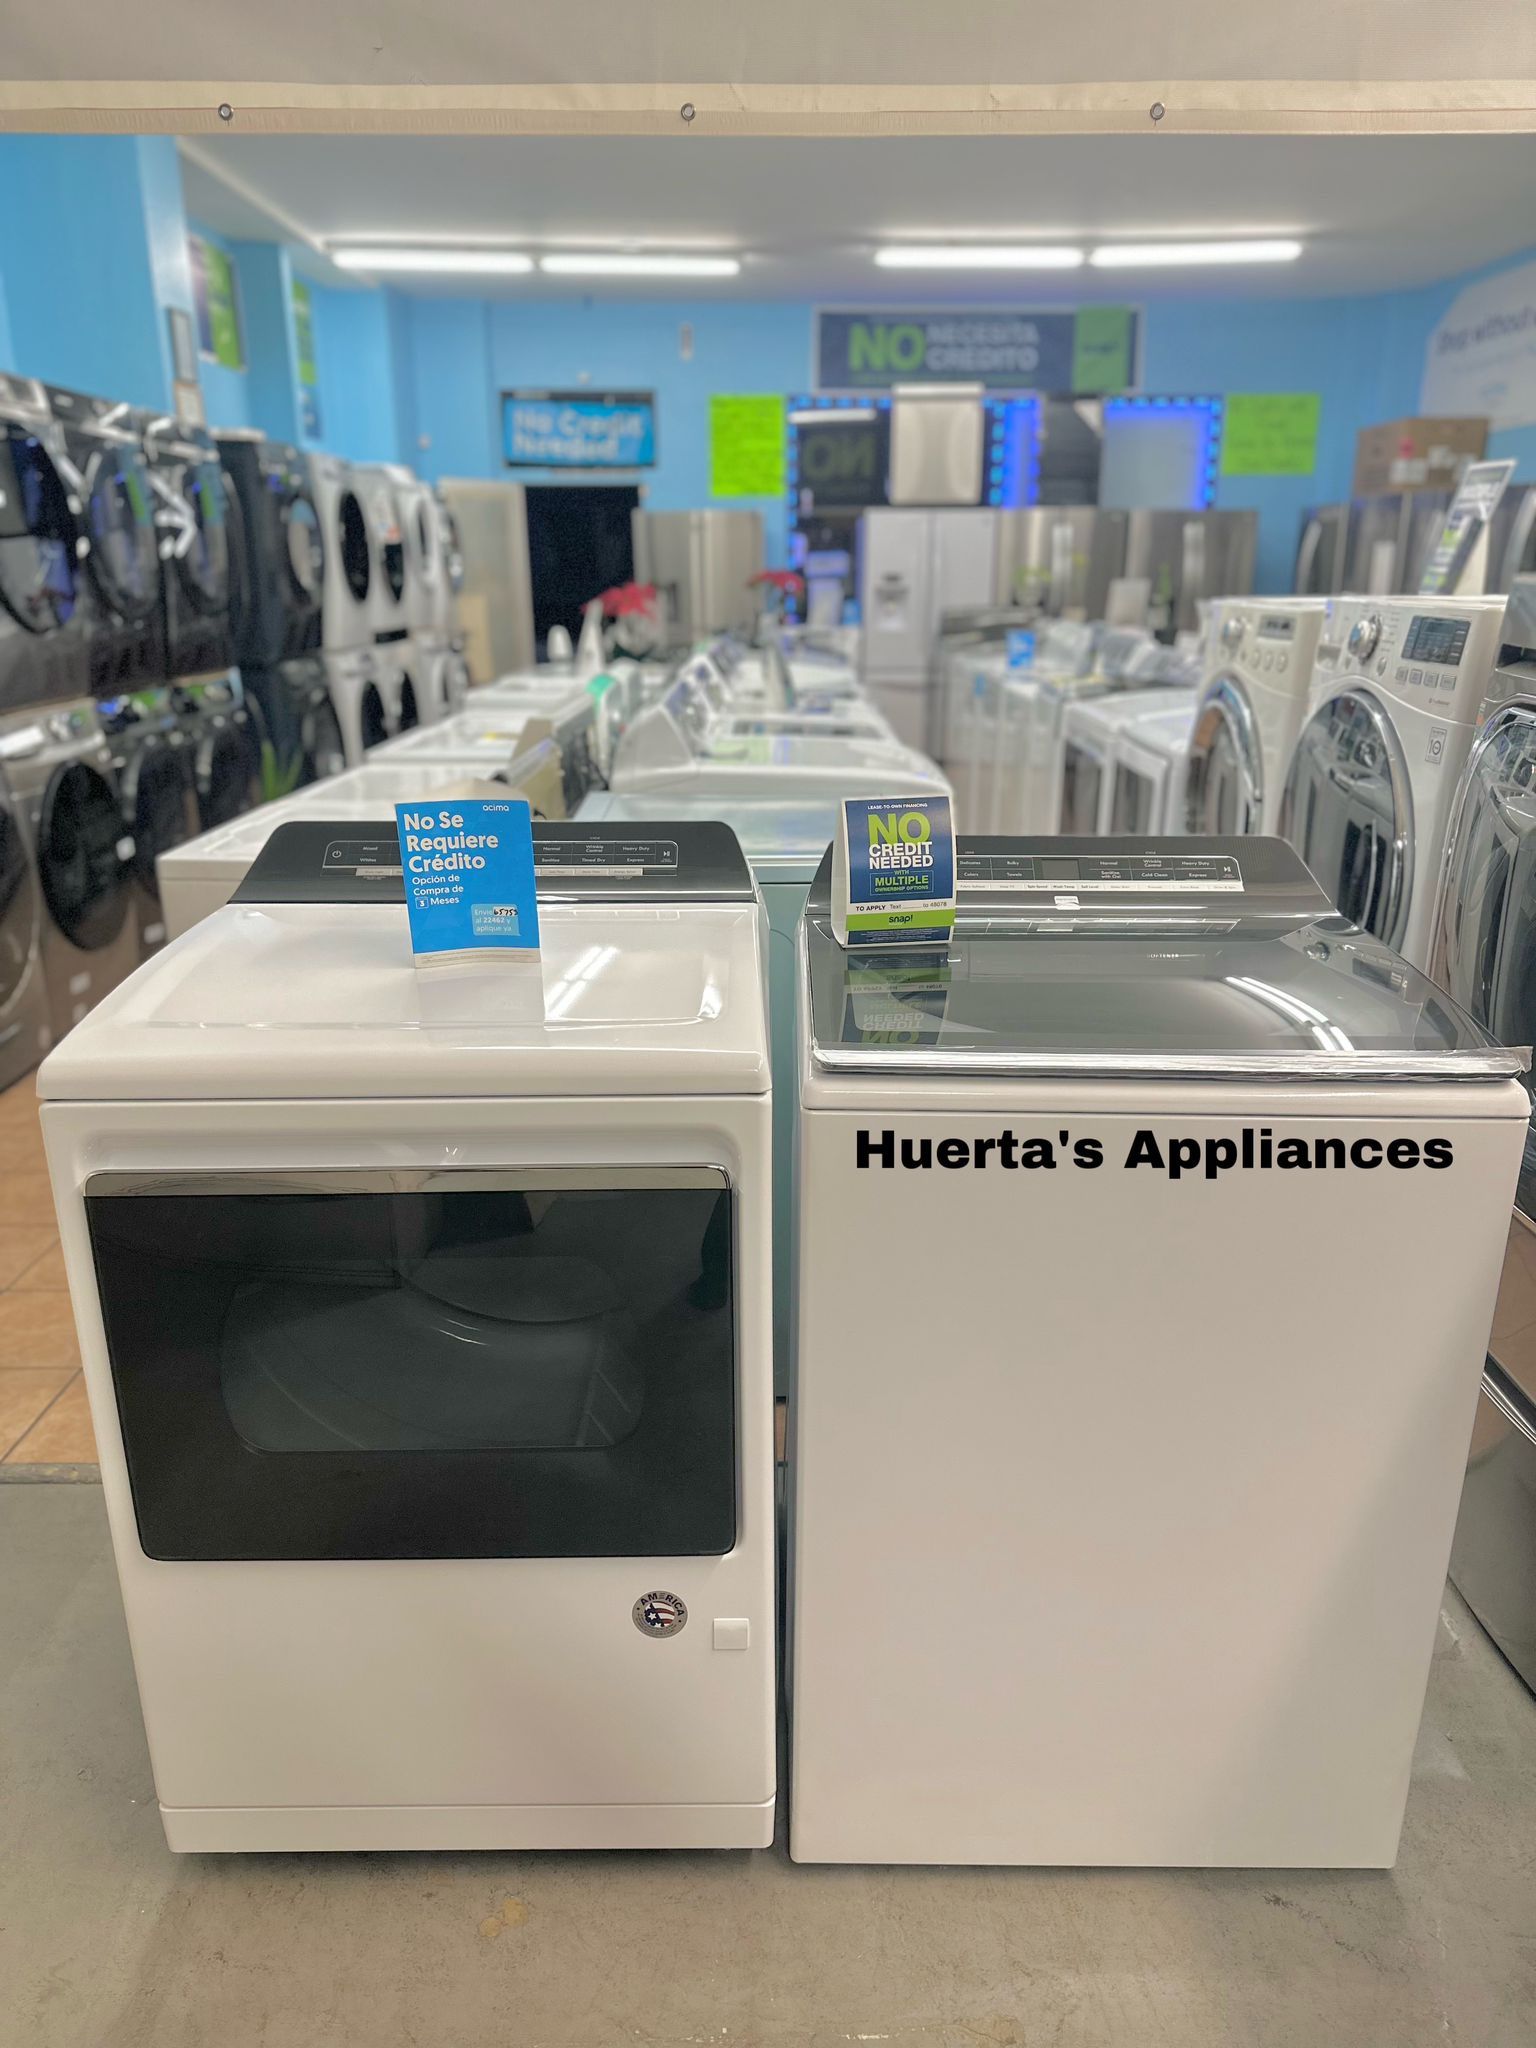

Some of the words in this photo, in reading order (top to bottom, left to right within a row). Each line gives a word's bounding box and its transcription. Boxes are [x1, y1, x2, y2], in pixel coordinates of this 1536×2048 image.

[850, 322, 926, 372] NO
[512, 408, 553, 434] No
[403, 813, 435, 831] No
[439, 811, 464, 829] Se
[867, 811, 931, 847] NO
[406, 831, 499, 853] Requiere
[868, 842, 933, 858] CREDIT
[408, 852, 486, 873] Crédito
[869, 855, 934, 870] NEEDED
[412, 876, 446, 885] Opción
[448, 874, 460, 882] de
[875, 875, 929, 887] MULTIPLE
[413, 887, 450, 896] Compra
[452, 885, 464, 893] de
[430, 897, 460, 905] Meses
[888, 915, 914, 924] snap!
[640, 1592, 685, 1617] AMERICA
